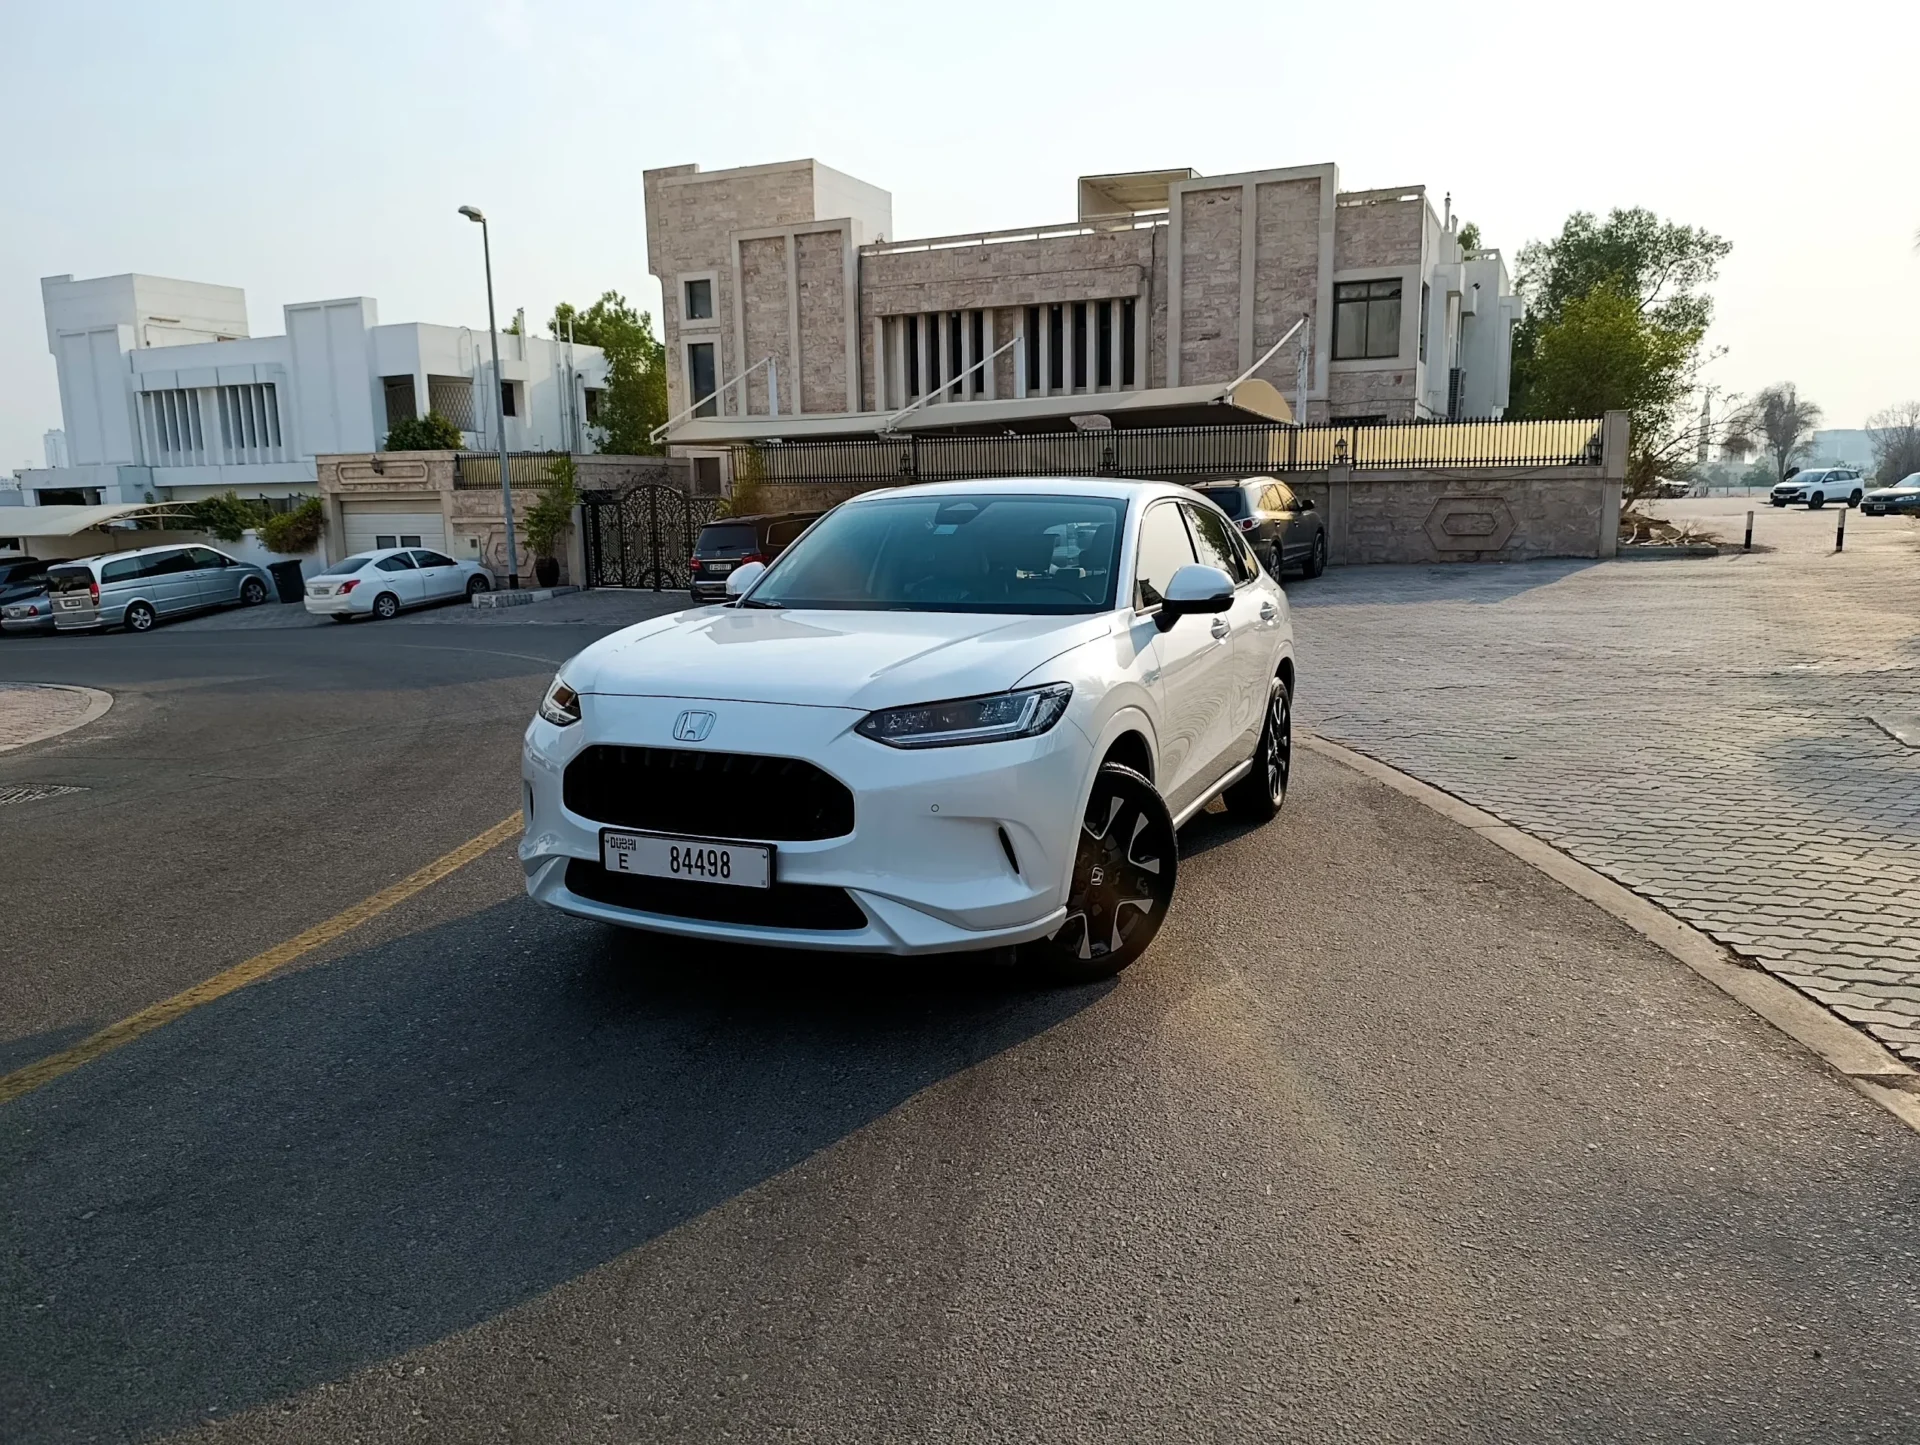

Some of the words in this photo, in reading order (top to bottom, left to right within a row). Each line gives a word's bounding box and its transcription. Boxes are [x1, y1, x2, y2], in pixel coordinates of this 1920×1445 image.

[610, 836, 637, 851] DUBAI
[618, 853, 630, 870] E
[670, 845, 731, 879] 84498
